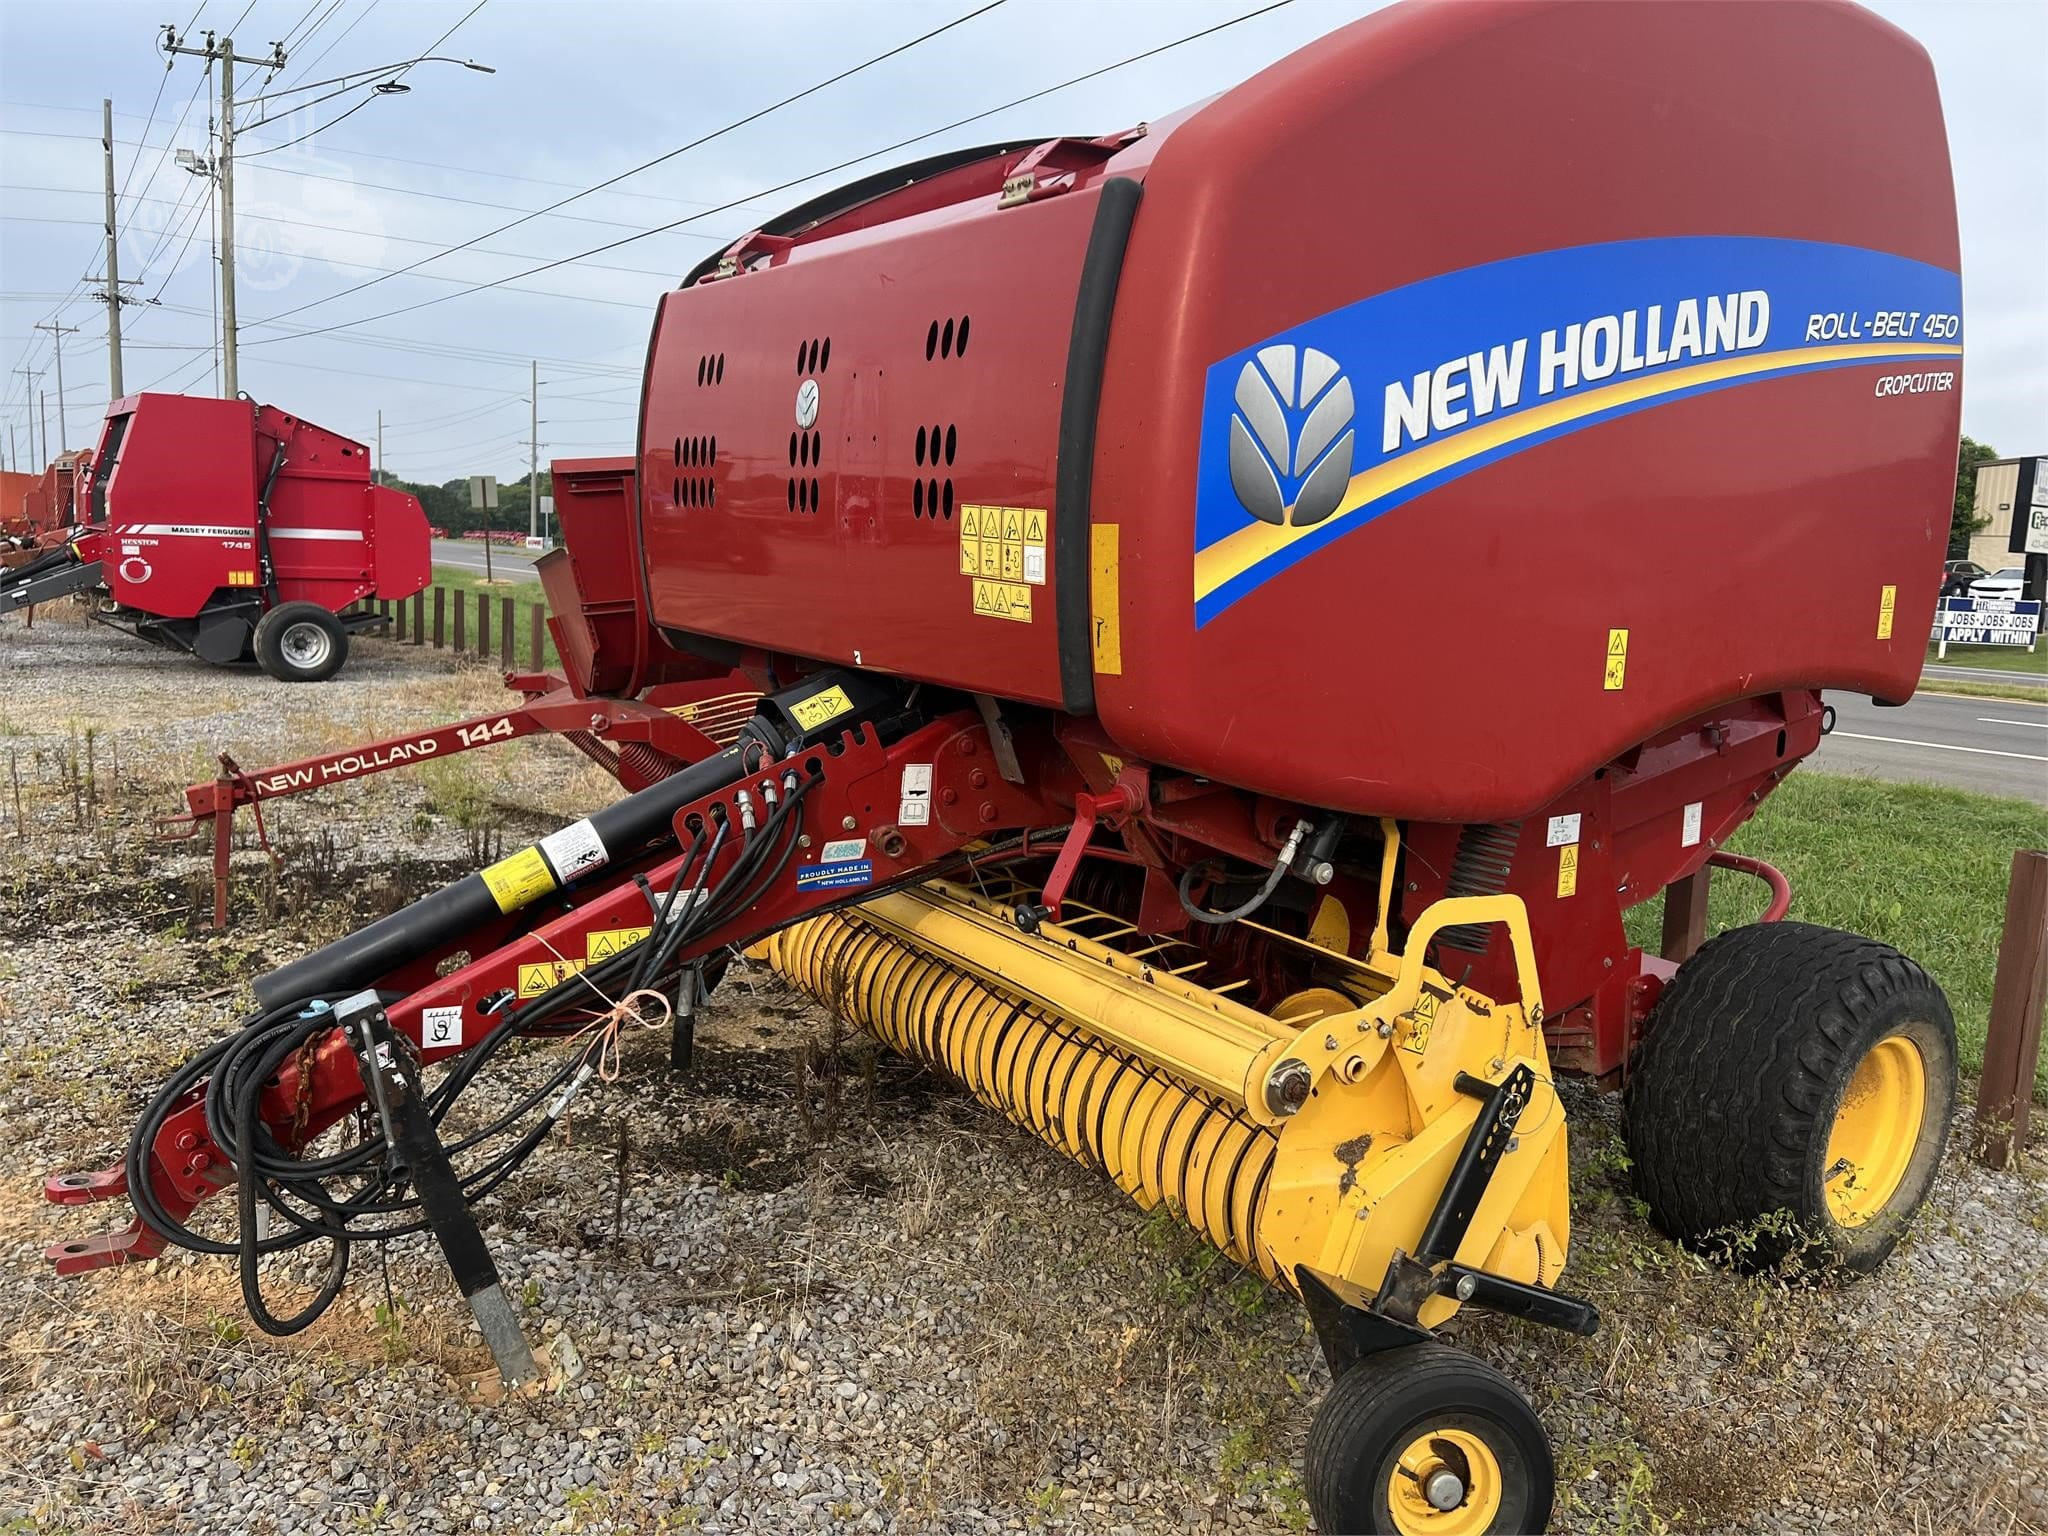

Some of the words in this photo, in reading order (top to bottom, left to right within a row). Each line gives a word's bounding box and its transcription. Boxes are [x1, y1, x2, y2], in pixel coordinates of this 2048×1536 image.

[1805, 311, 1921, 342] ROLL-BELT
[1922, 313, 1959, 339] 450
[1382, 338, 1528, 454] NEW
[1538, 290, 1770, 396] HOLLAND
[1875, 372, 1954, 398] CROPCUTTER
[171, 527, 205, 535] MASSEY
[208, 528, 250, 536] FERGUSON
[222, 541, 252, 550] 1745
[1950, 613, 1976, 625] JOBS
[1981, 615, 2005, 627] JOBS
[2009, 616, 2034, 628] JOBS
[1948, 628, 1986, 642] APPLY
[1990, 630, 2031, 644] WITHIN
[255, 768, 314, 795] NEW
[320, 738, 437, 779] HOLLAND
[456, 717, 514, 747] 144
[800, 868, 835, 880] PROUDLY
[837, 865, 858, 874] MADE
